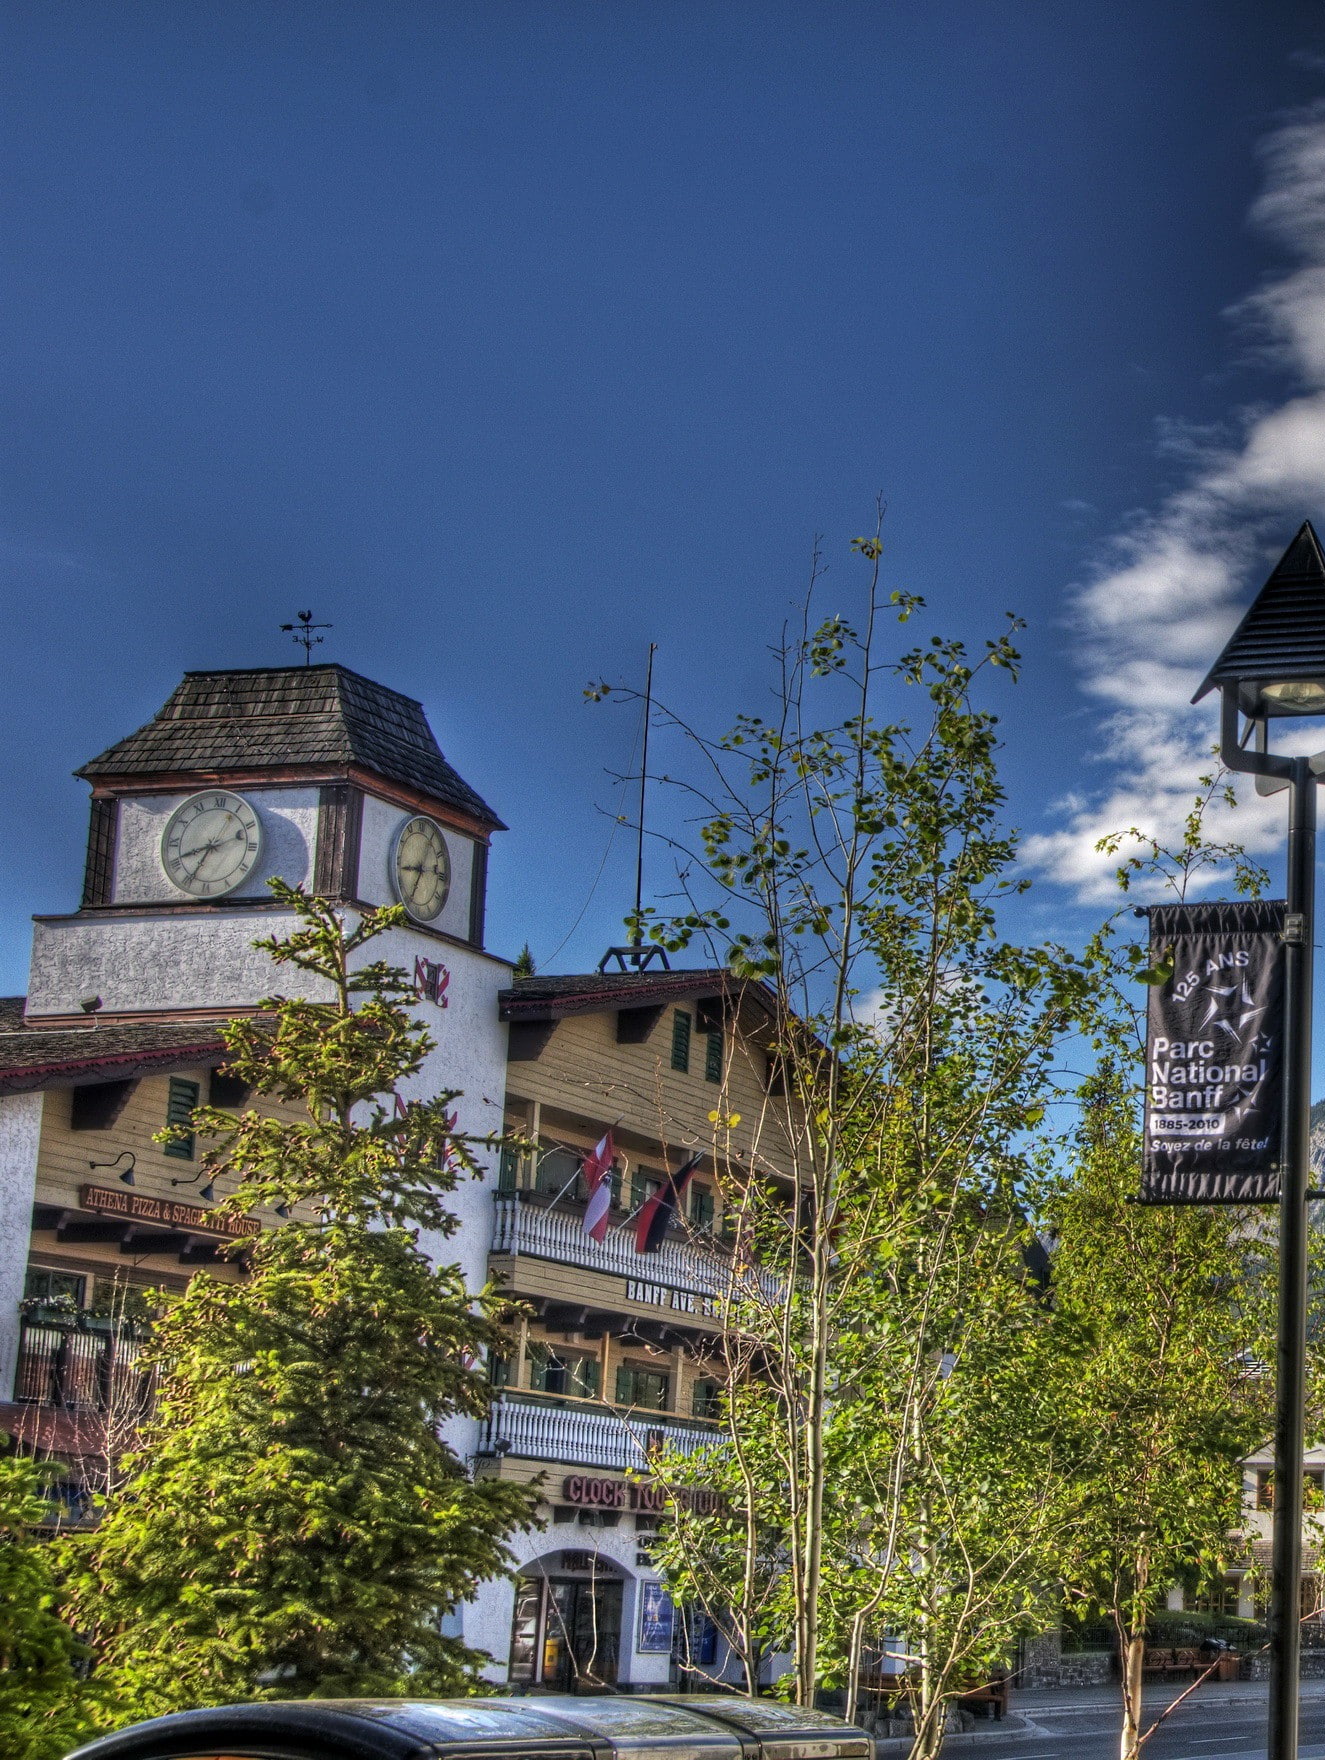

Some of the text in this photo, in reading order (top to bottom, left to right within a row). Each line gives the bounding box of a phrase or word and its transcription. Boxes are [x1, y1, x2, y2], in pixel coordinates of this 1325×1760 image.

[1172, 950, 1250, 1002] 125 ANS
[1152, 1037, 1215, 1060] Parc
[1152, 1059, 1266, 1084] National
[1151, 1085, 1224, 1109] Banff
[1154, 1119, 1220, 1130] 1885-2010
[1150, 1136, 1270, 1154] Soyez de la fête!
[86, 1188, 128, 1212] ATHENA
[131, 1196, 160, 1218] PIZZA
[163, 1203, 170, 1220] &
[627, 1280, 699, 1314] BANFF AVE.
[569, 1475, 626, 1506] CLOCK
